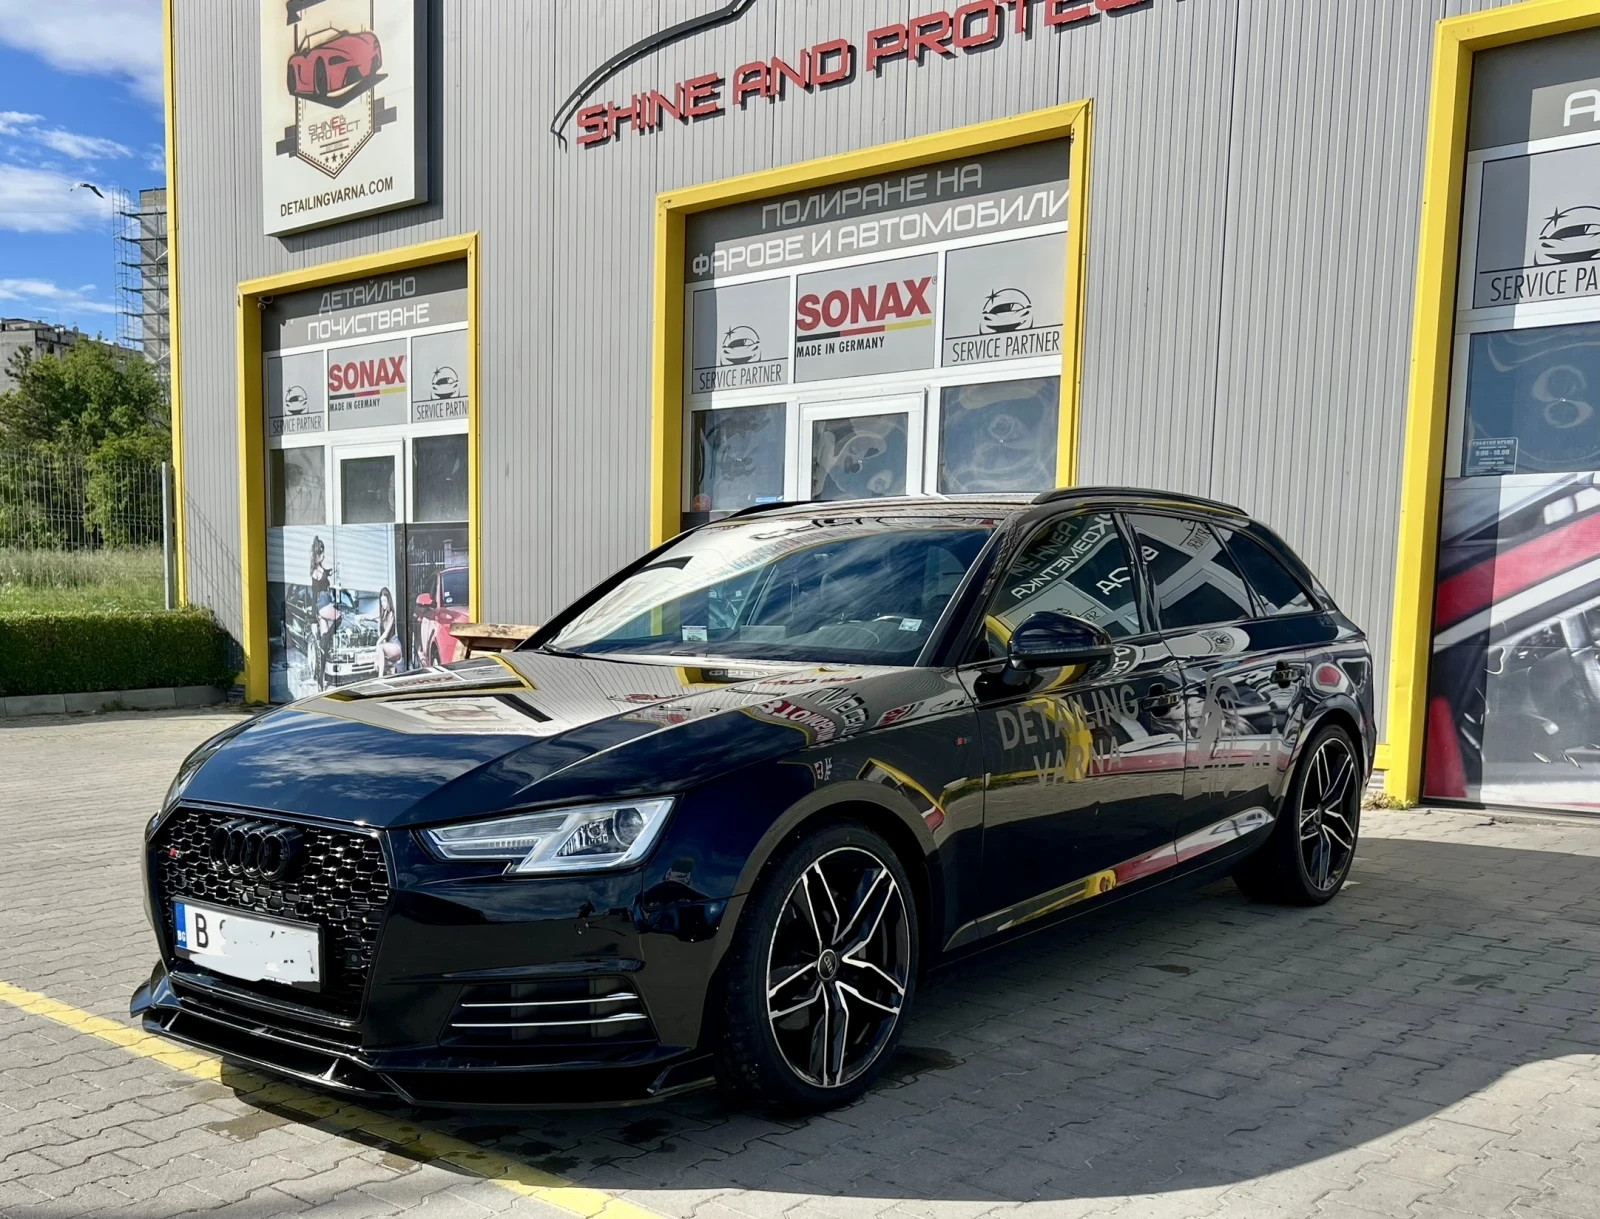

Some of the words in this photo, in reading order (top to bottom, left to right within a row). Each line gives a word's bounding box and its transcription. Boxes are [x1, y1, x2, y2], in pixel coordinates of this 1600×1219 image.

[576, 72, 719, 145] SHINE
[732, 38, 849, 105] AND
[311, 119, 361, 144] PROTECT
[280, 176, 394, 217] DETAILINGVARNA.COM
[762, 173, 927, 230] ПОЛИРАНЕ
[937, 163, 982, 197] НА
[692, 235, 803, 276] ФАРОВЕ
[811, 229, 831, 257] И
[319, 276, 416, 317] ДЕТАЙЛНО
[796, 276, 932, 331] SONAX
[1491, 269, 1568, 302] SERVICE
[307, 302, 430, 340] ПОЧИСТВАНЕ
[796, 343, 823, 358] MADE
[825, 342, 836, 354] IN
[838, 336, 885, 353] GERMANY
[952, 338, 1000, 363] SERVICE
[1005, 332, 1060, 355] PARTNER
[328, 355, 406, 392] SONAX
[699, 368, 738, 390] SERVICE
[740, 364, 782, 386] PARTNER
[329, 401, 345, 412] MADE
[346, 401, 353, 410] IN
[353, 398, 381, 410] GERMANY
[416, 402, 444, 420] SERVICE
[446, 400, 469, 417] PARTN
[272, 418, 296, 434] SERVICE
[296, 416, 322, 430] PARTNER
[995, 684, 1140, 751] DETAILING
[1033, 736, 1122, 788] VARNA
[177, 930, 187, 942] BG
[195, 912, 209, 949] B
